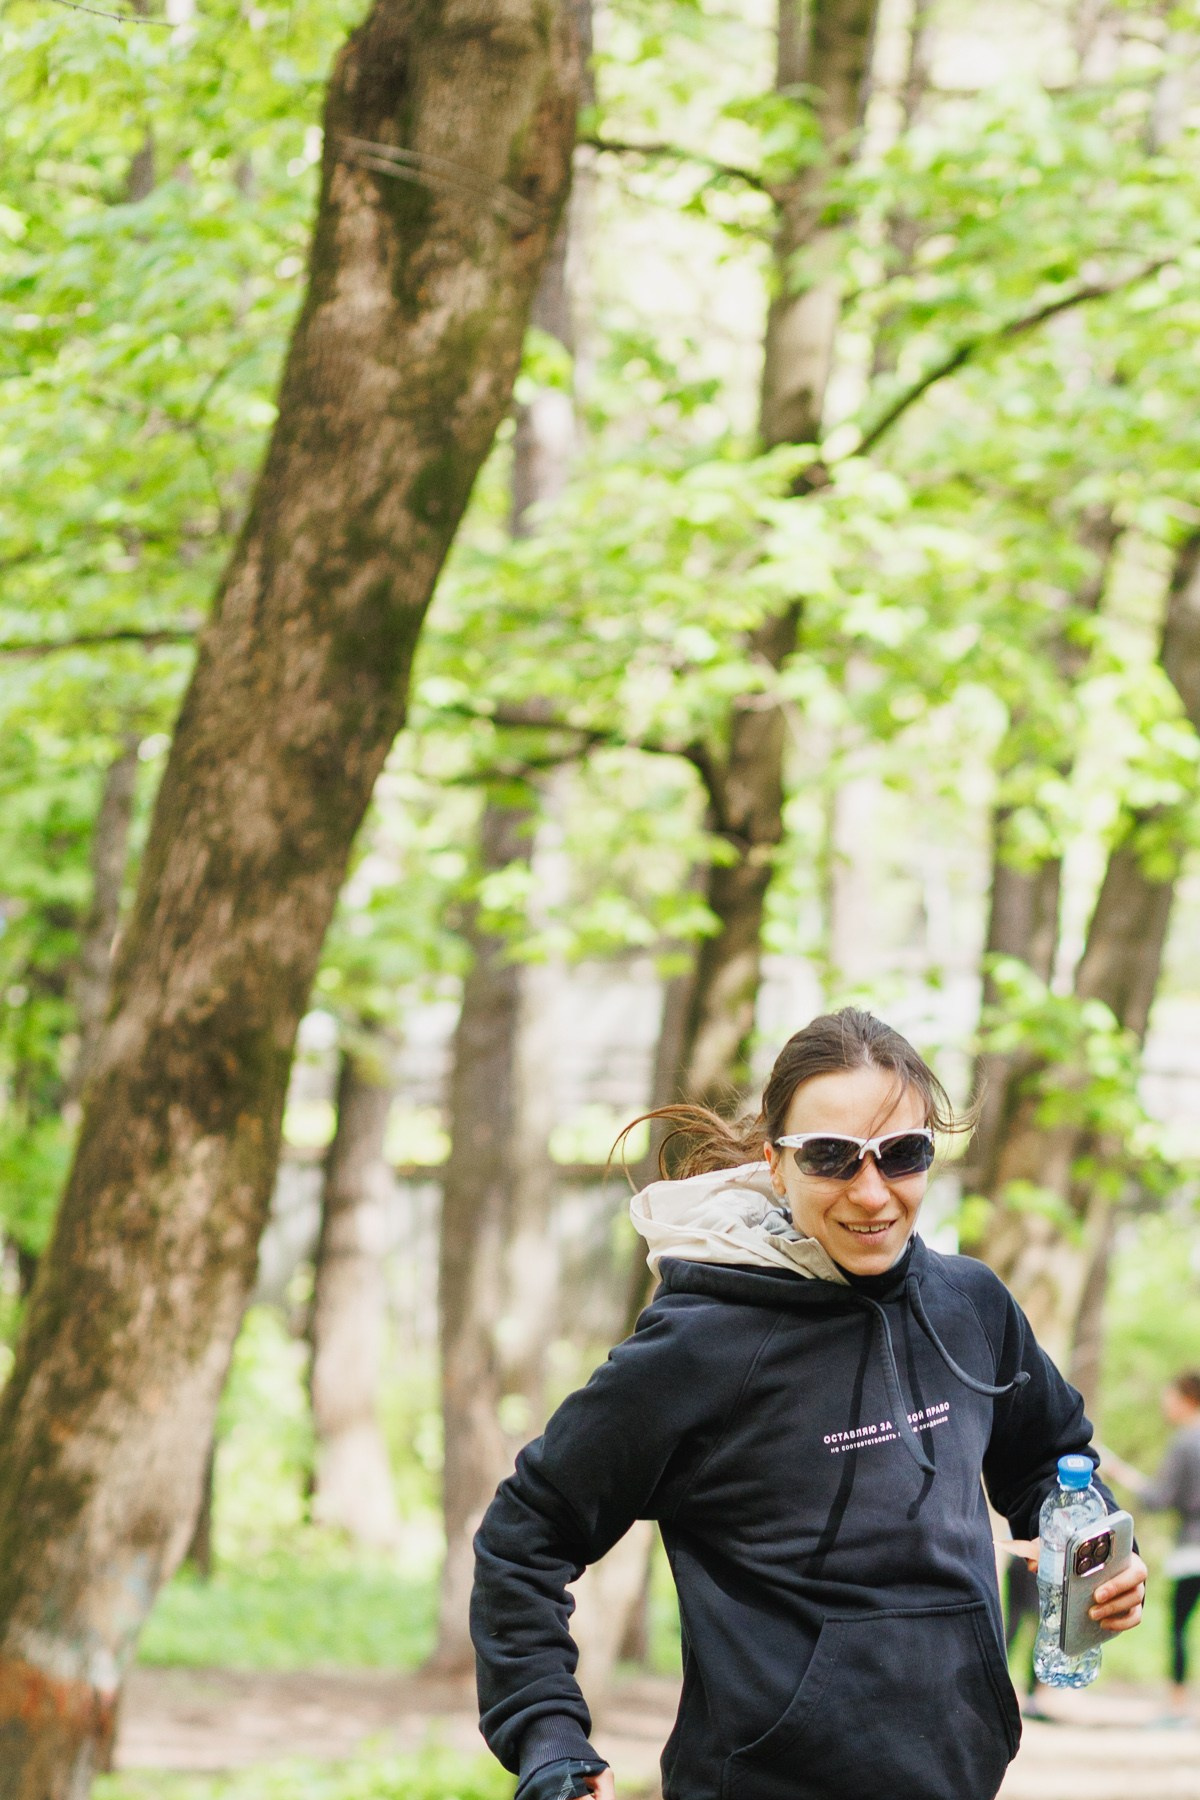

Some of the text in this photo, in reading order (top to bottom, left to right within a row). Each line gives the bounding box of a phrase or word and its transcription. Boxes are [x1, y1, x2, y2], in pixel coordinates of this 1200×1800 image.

[823, 1424, 877, 1444] ОСТАВЛЯЮ
[880, 1421, 893, 1432] ЗА
[925, 1401, 950, 1418] ПРАВО
